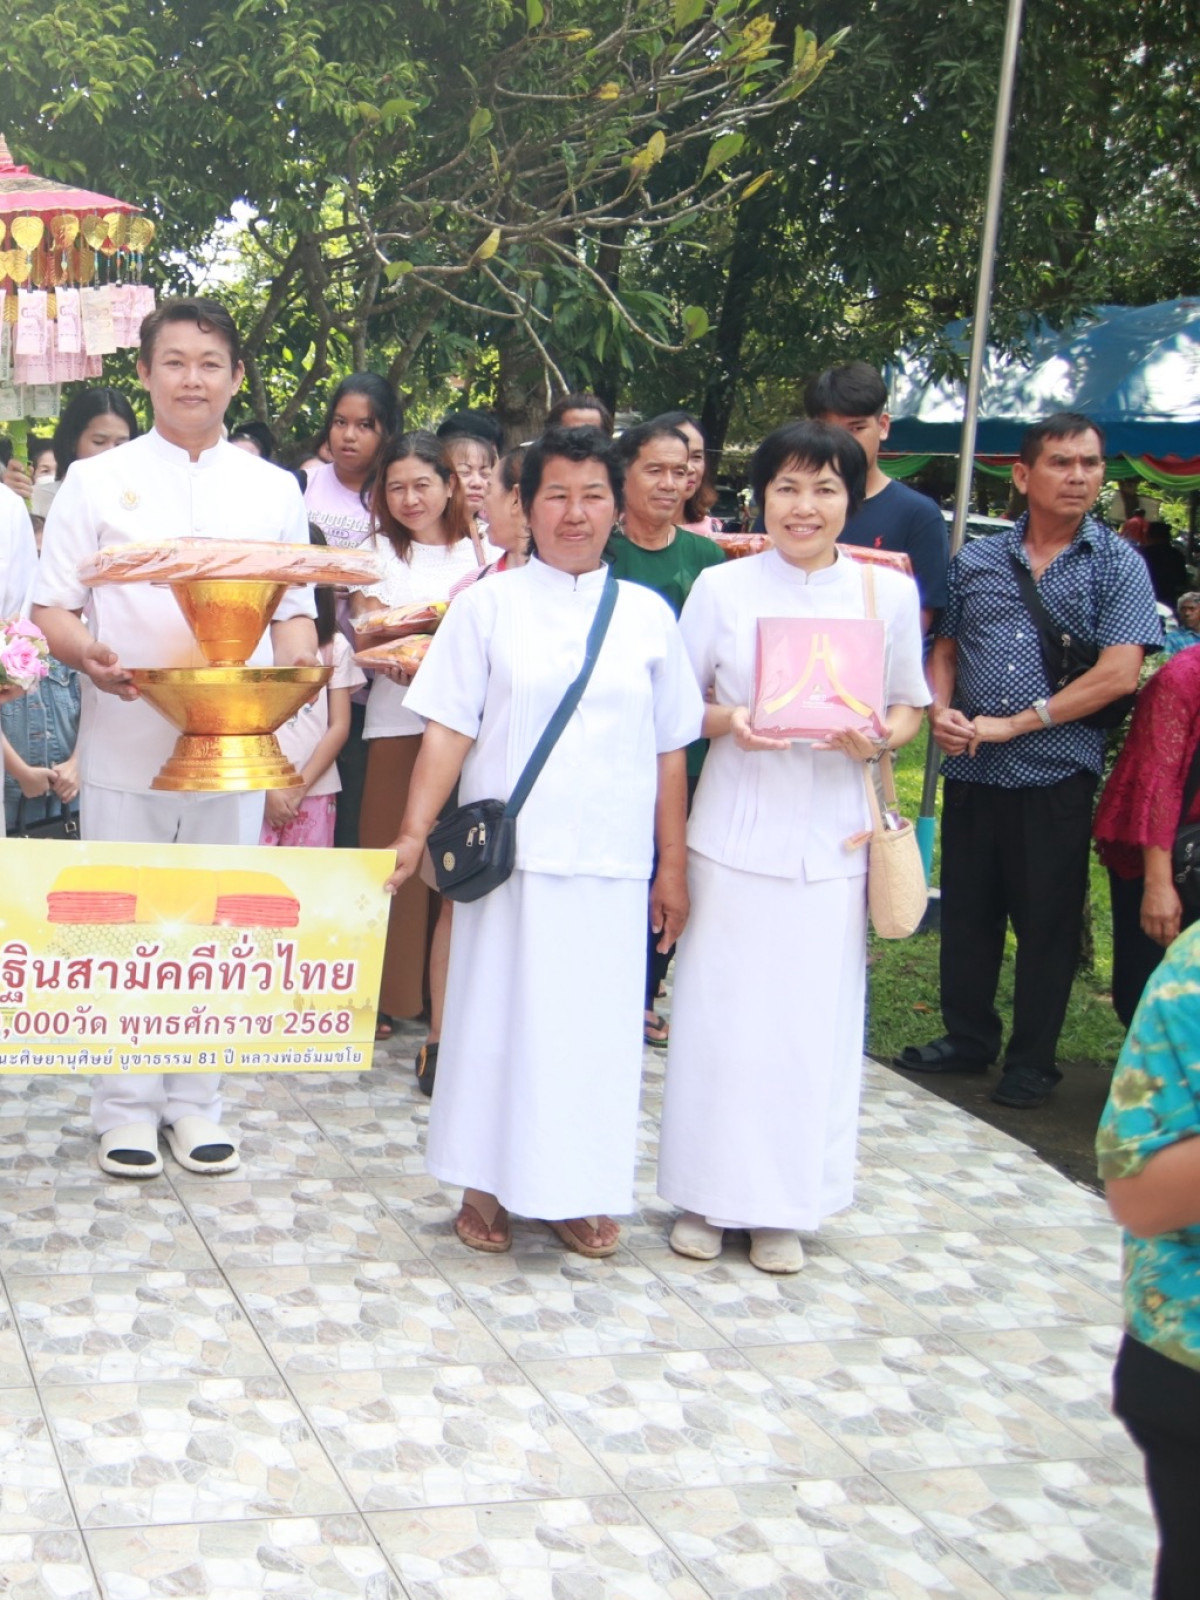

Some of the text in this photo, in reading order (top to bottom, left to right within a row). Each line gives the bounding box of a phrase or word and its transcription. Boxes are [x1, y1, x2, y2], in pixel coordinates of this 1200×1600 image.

[118, 1006, 273, 1045] พุทธศักราช
[283, 1012, 351, 1035] 2568
[120, 1053, 192, 1071] บูชาธรรม
[198, 1052, 217, 1064] 81
[224, 1048, 234, 1064] ปี
[241, 1046, 362, 1064] หลวงพ่อธัมมชโย
